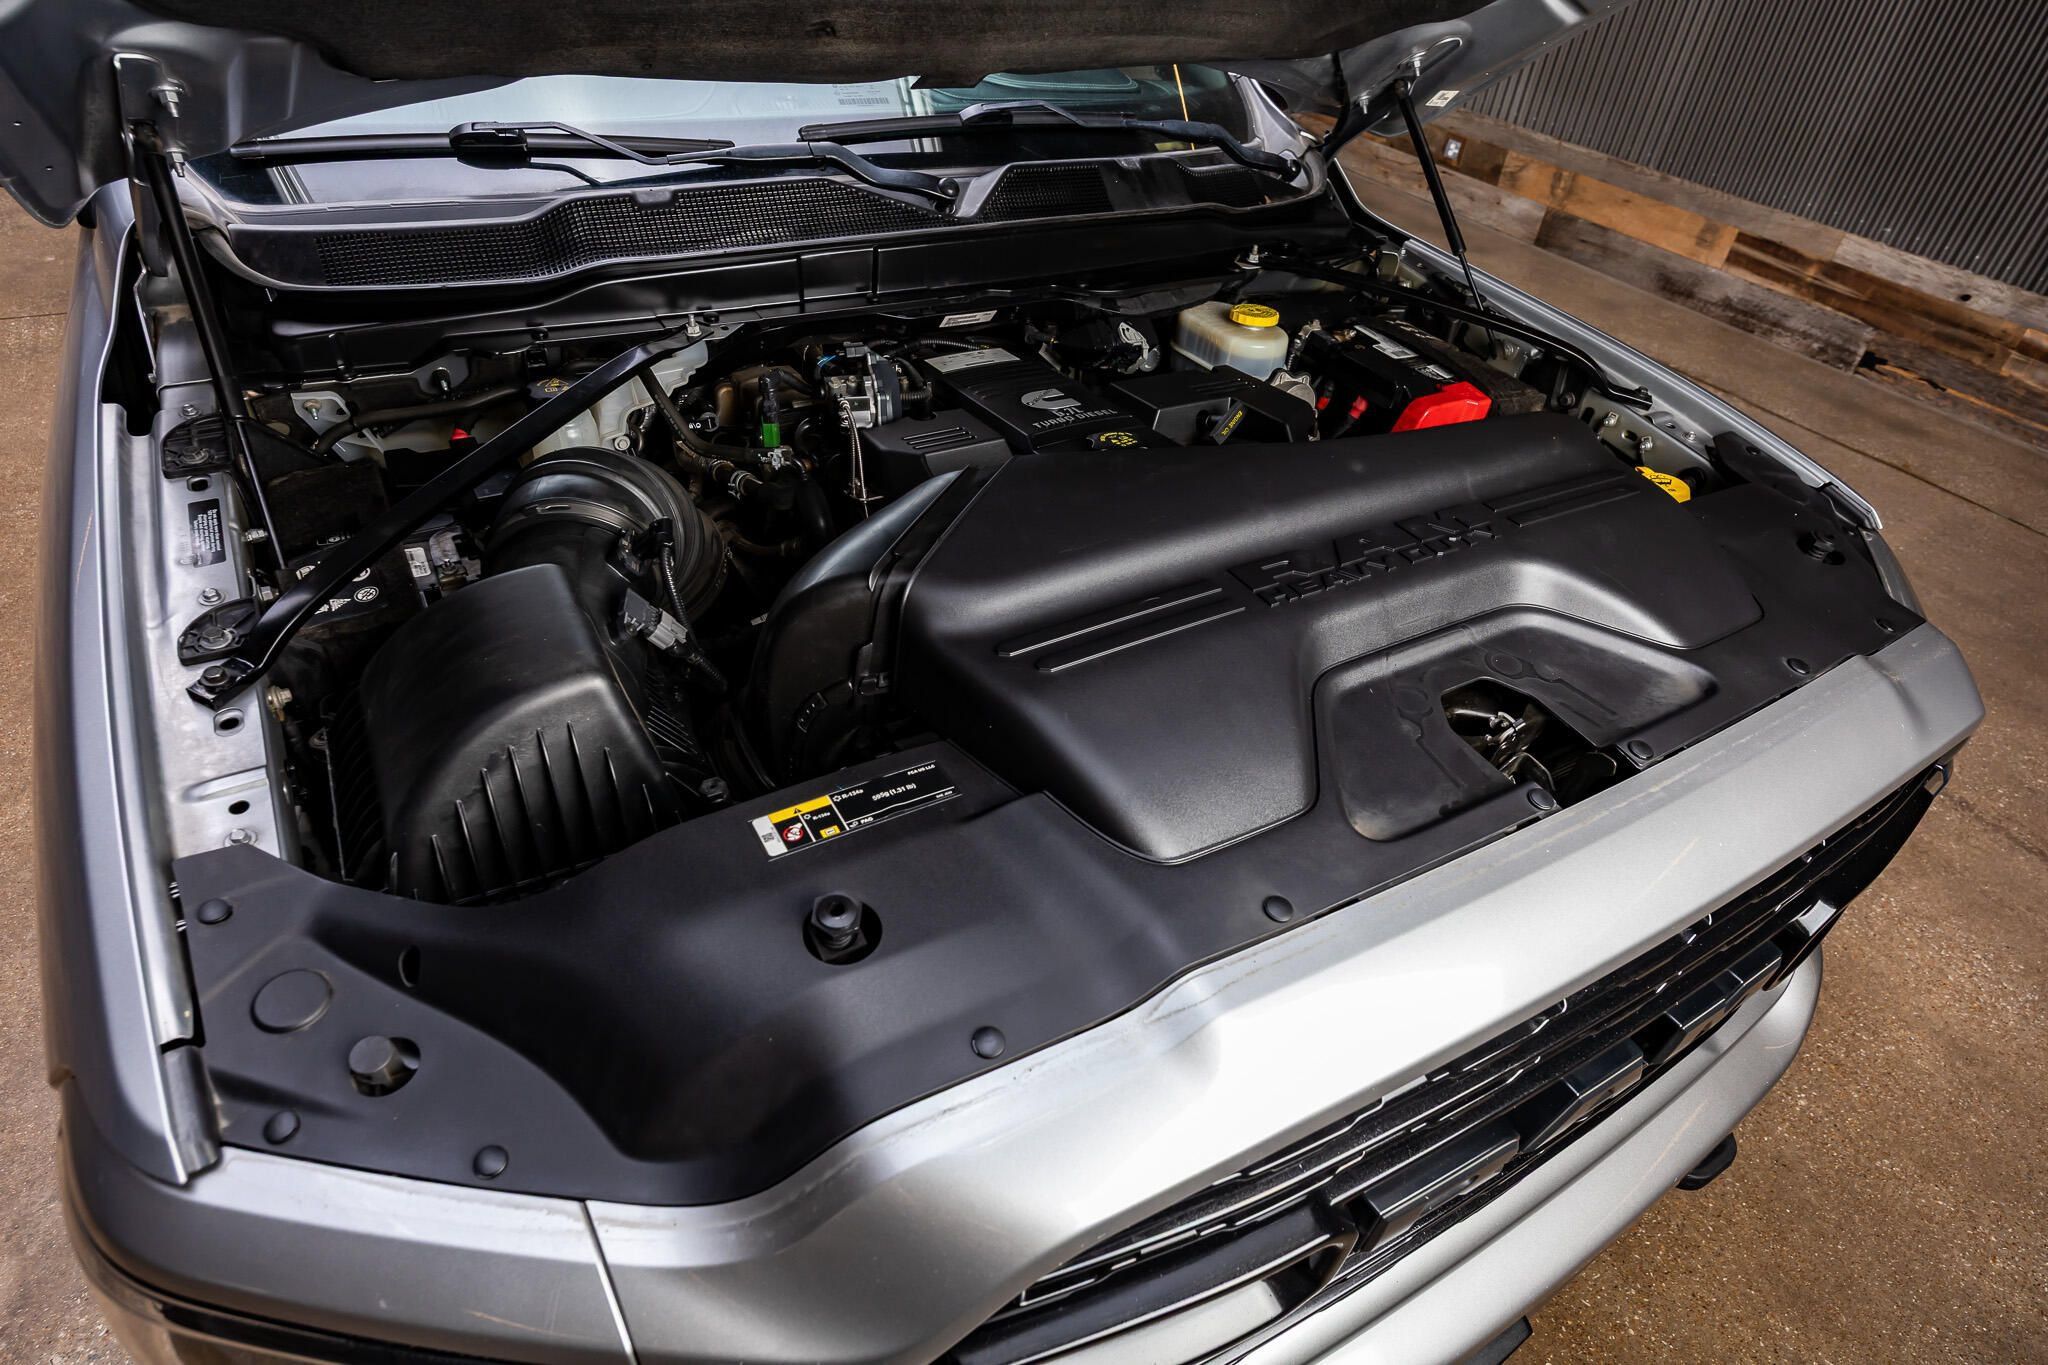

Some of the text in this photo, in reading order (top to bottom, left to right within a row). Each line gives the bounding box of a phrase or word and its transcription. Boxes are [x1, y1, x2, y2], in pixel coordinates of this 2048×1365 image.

[1032, 408, 1118, 429] TURBO DIESEL
[1228, 410, 1243, 429] ENGINE
[1254, 522, 1502, 608] HEAVY DUTY
[907, 768, 919, 776] FCA
[841, 788, 864, 800] R-134a
[889, 785, 906, 797] (1.31
[906, 783, 917, 791] lb)
